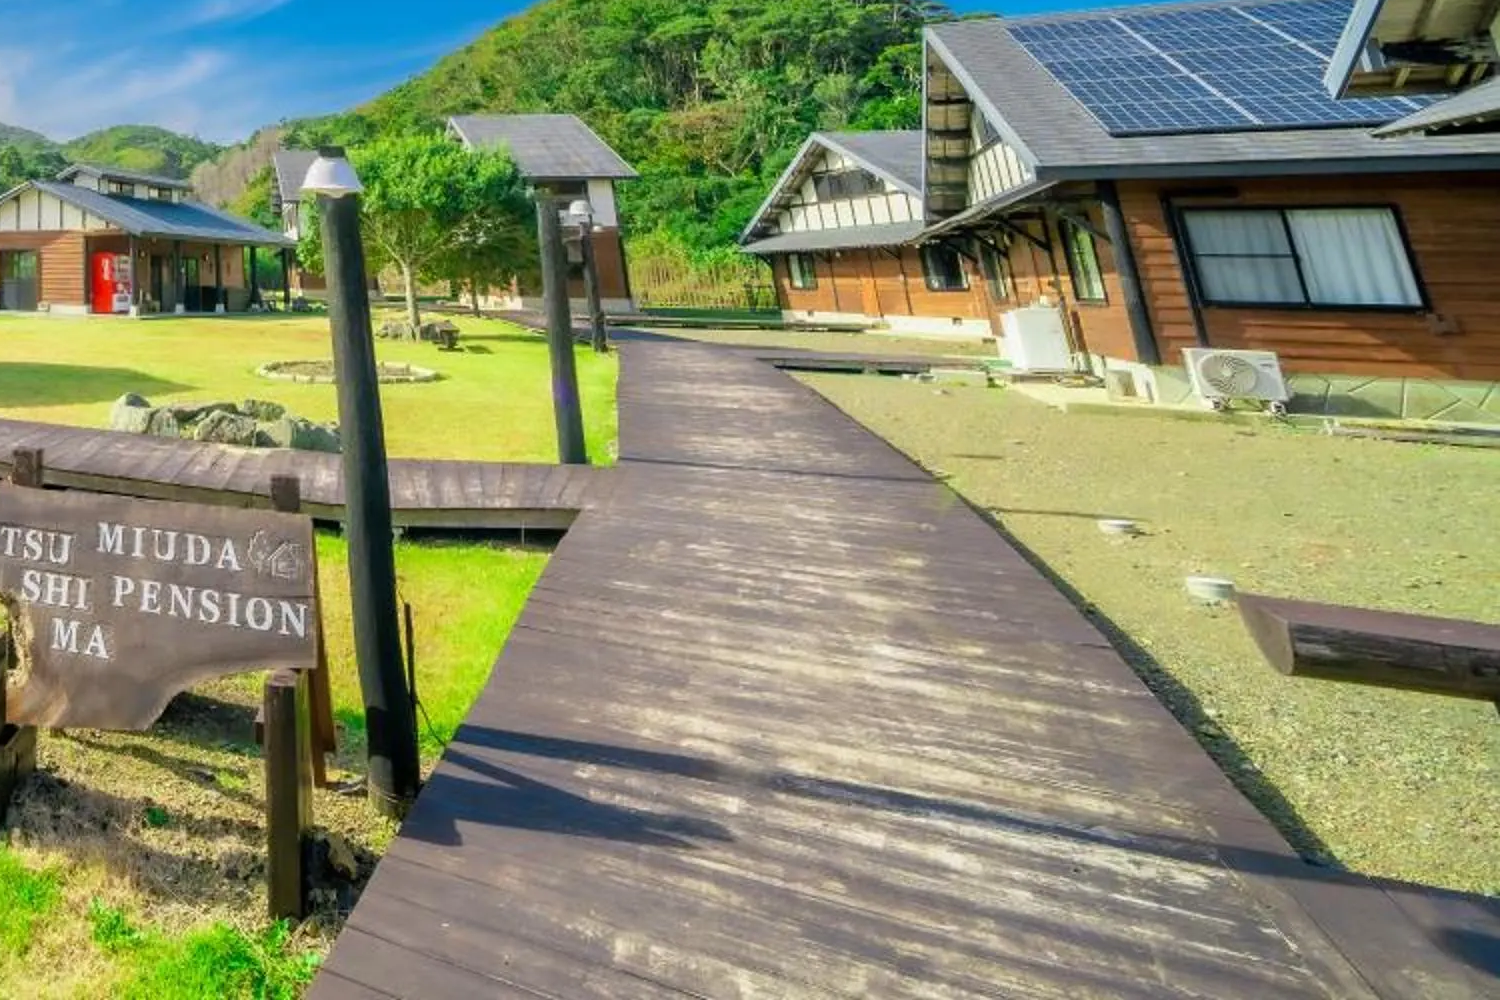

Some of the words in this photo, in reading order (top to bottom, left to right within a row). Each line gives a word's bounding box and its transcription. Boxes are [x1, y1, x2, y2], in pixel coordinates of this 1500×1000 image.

[1, 527, 76, 564] TSU
[97, 522, 243, 571] MIUDA
[21, 570, 91, 610] SHI
[112, 575, 308, 638] PENSION
[52, 617, 109, 659] MA
